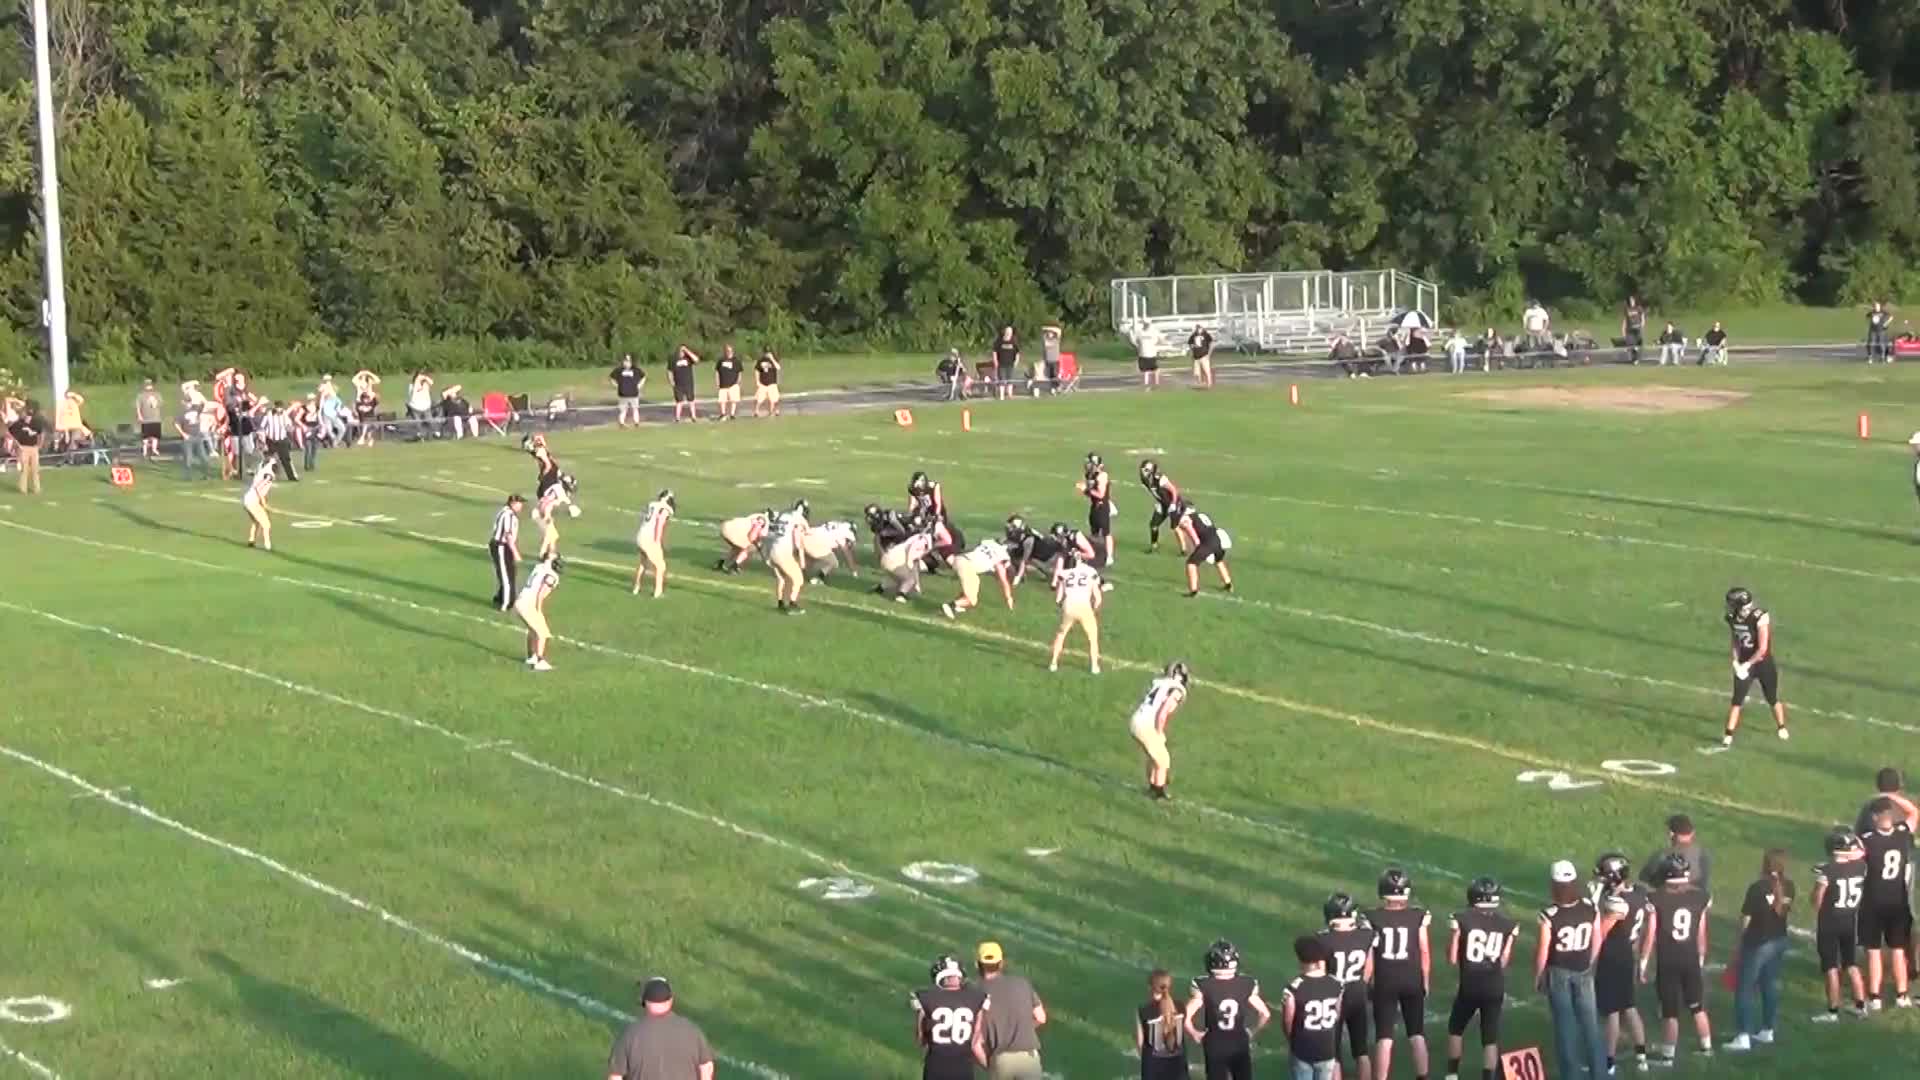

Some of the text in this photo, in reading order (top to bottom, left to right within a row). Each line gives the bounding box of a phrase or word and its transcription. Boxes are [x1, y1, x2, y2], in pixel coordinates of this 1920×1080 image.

[1065, 572, 1088, 587] 22
[1882, 850, 1901, 880] 8
[1834, 877, 1864, 908] 15
[1555, 922, 1593, 952] 30
[1672, 908, 1691, 941] 9
[1381, 927, 1409, 960] 11
[1466, 929, 1503, 963] 64
[1333, 949, 1367, 983] 12
[931, 1006, 974, 1045] 26
[1217, 998, 1239, 1030] 3
[1303, 998, 1338, 1030] 25
[1509, 1051, 1540, 1080] 30
